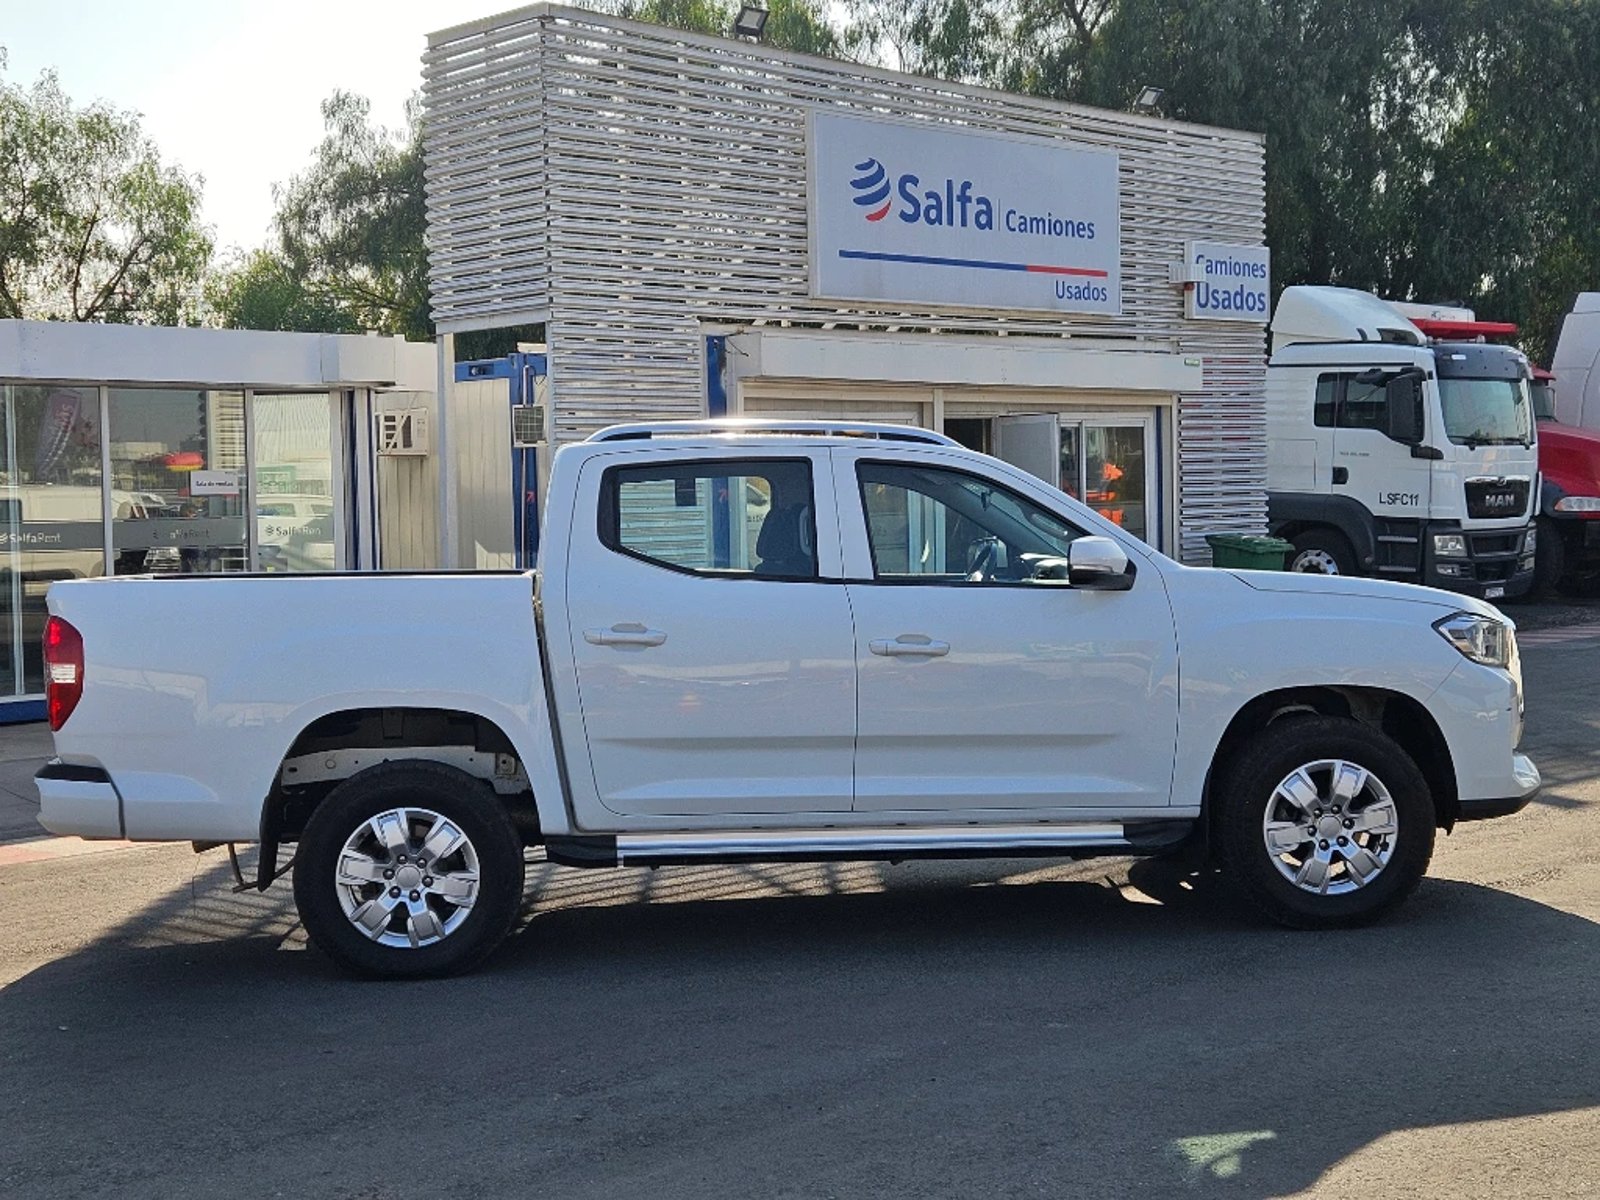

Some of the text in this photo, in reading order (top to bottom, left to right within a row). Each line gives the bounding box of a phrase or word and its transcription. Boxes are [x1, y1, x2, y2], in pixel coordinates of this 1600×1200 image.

[898, 174, 1095, 240] Salfa Camiones
[1055, 279, 1108, 302] Usados
[1196, 281, 1266, 312] Usados
[1379, 492, 1419, 506] LSFC11
[1485, 494, 1515, 507] MAN
